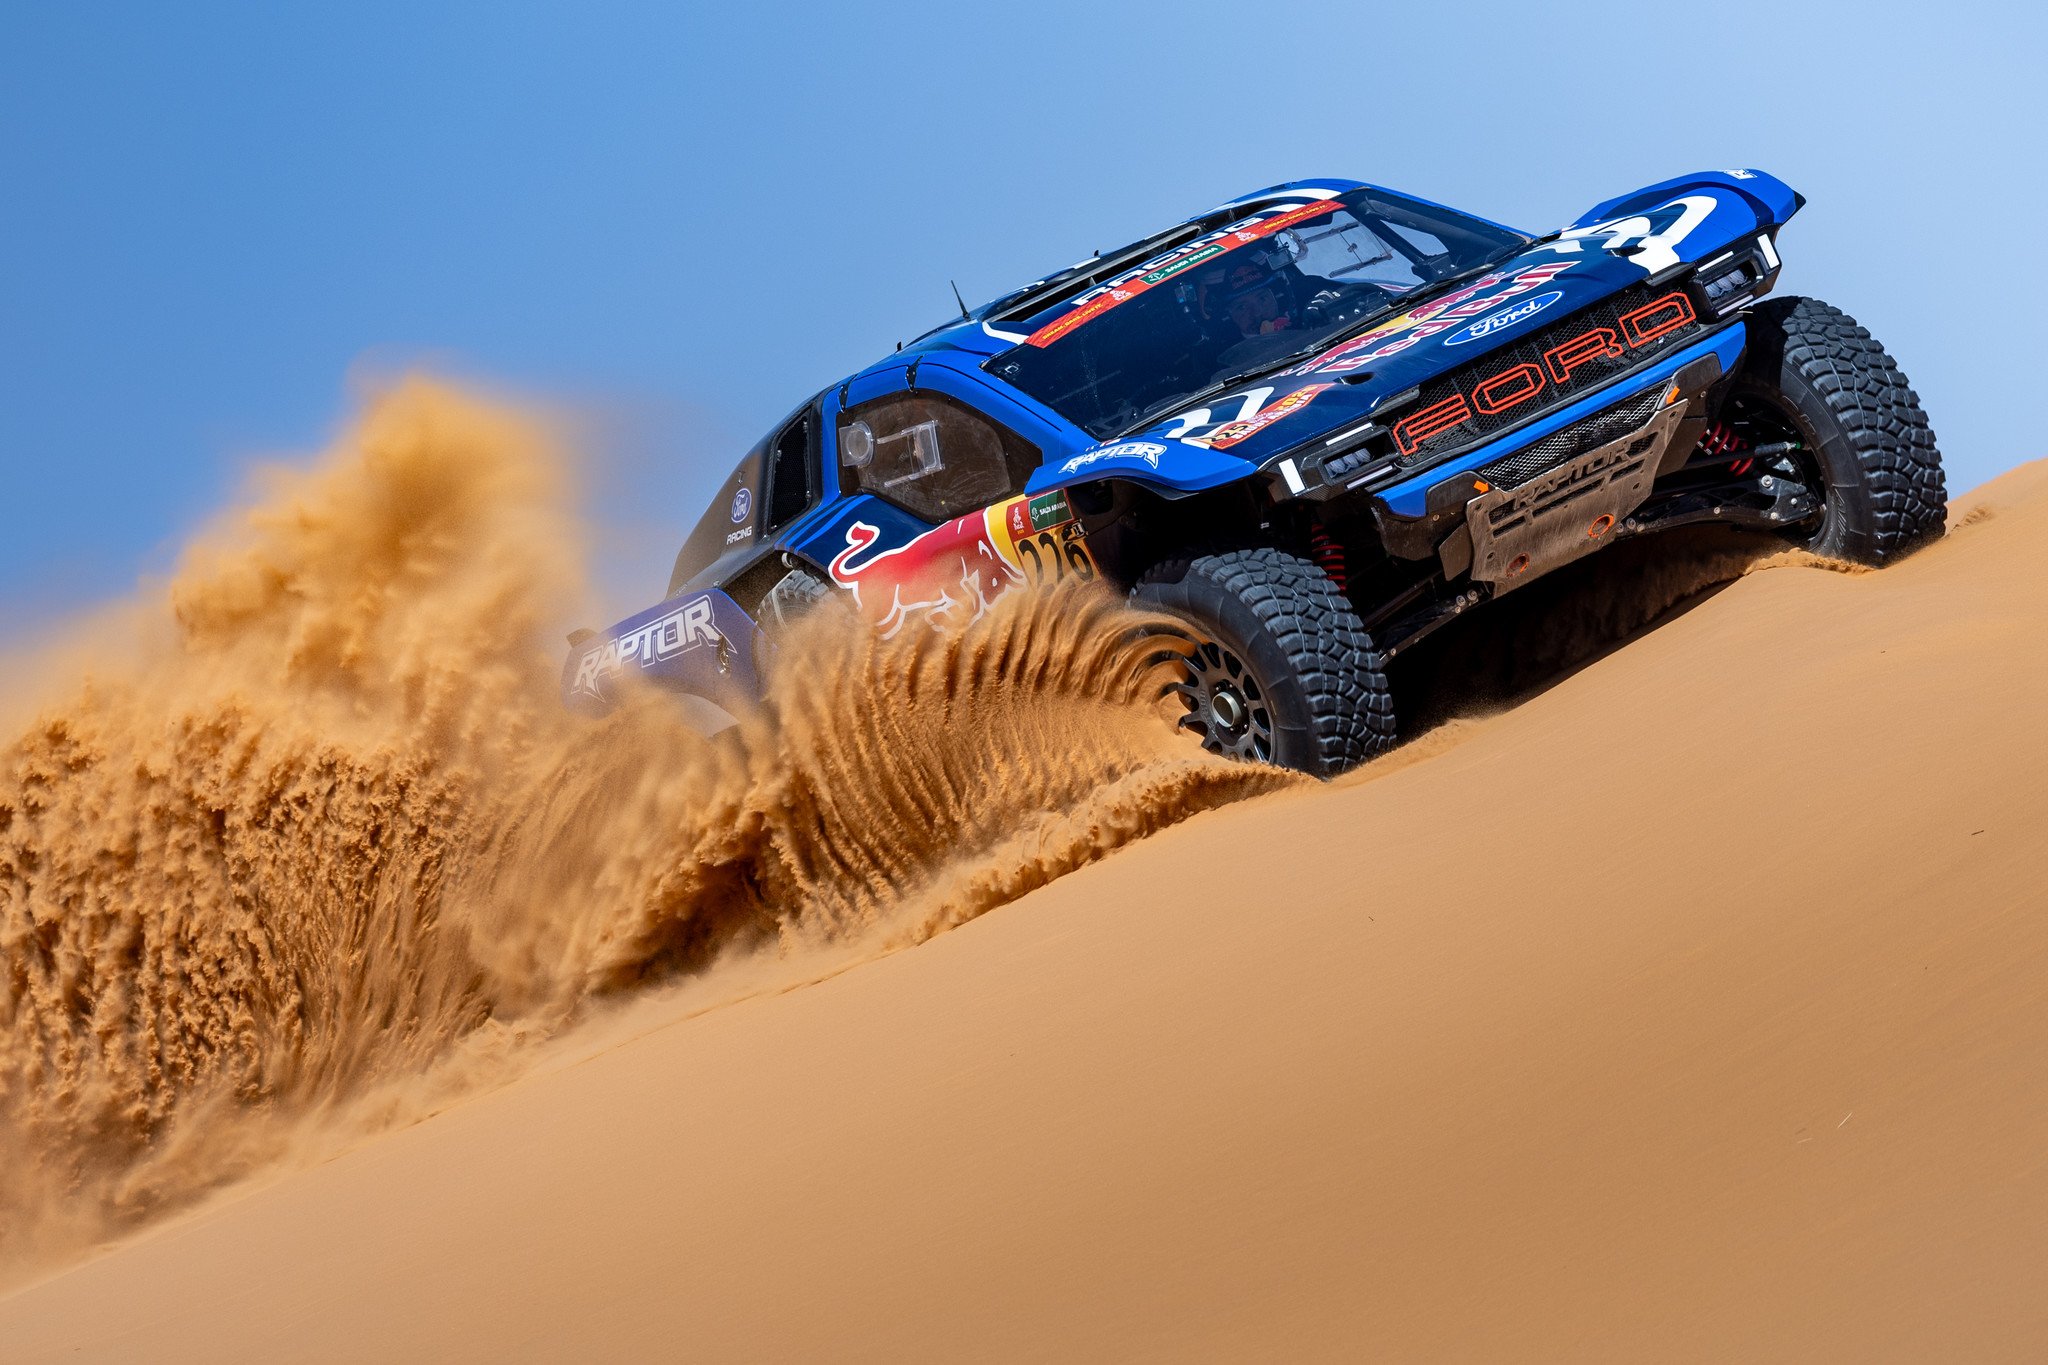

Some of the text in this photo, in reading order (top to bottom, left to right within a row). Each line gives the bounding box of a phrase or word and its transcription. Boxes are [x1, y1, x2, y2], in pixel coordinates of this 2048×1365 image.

[1071, 217, 1264, 306] RACING
[1165, 247, 1218, 273] SAUDI ARABIA
[1314, 260, 1582, 374] Red Bull
[1468, 300, 1541, 338] Ford
[1392, 292, 1696, 455] FORD
[1058, 441, 1167, 473] RAPTOR
[1040, 501, 1067, 516] SAUDI ARABIA
[726, 526, 753, 545] RACING
[571, 595, 737, 702] RAPTOR
